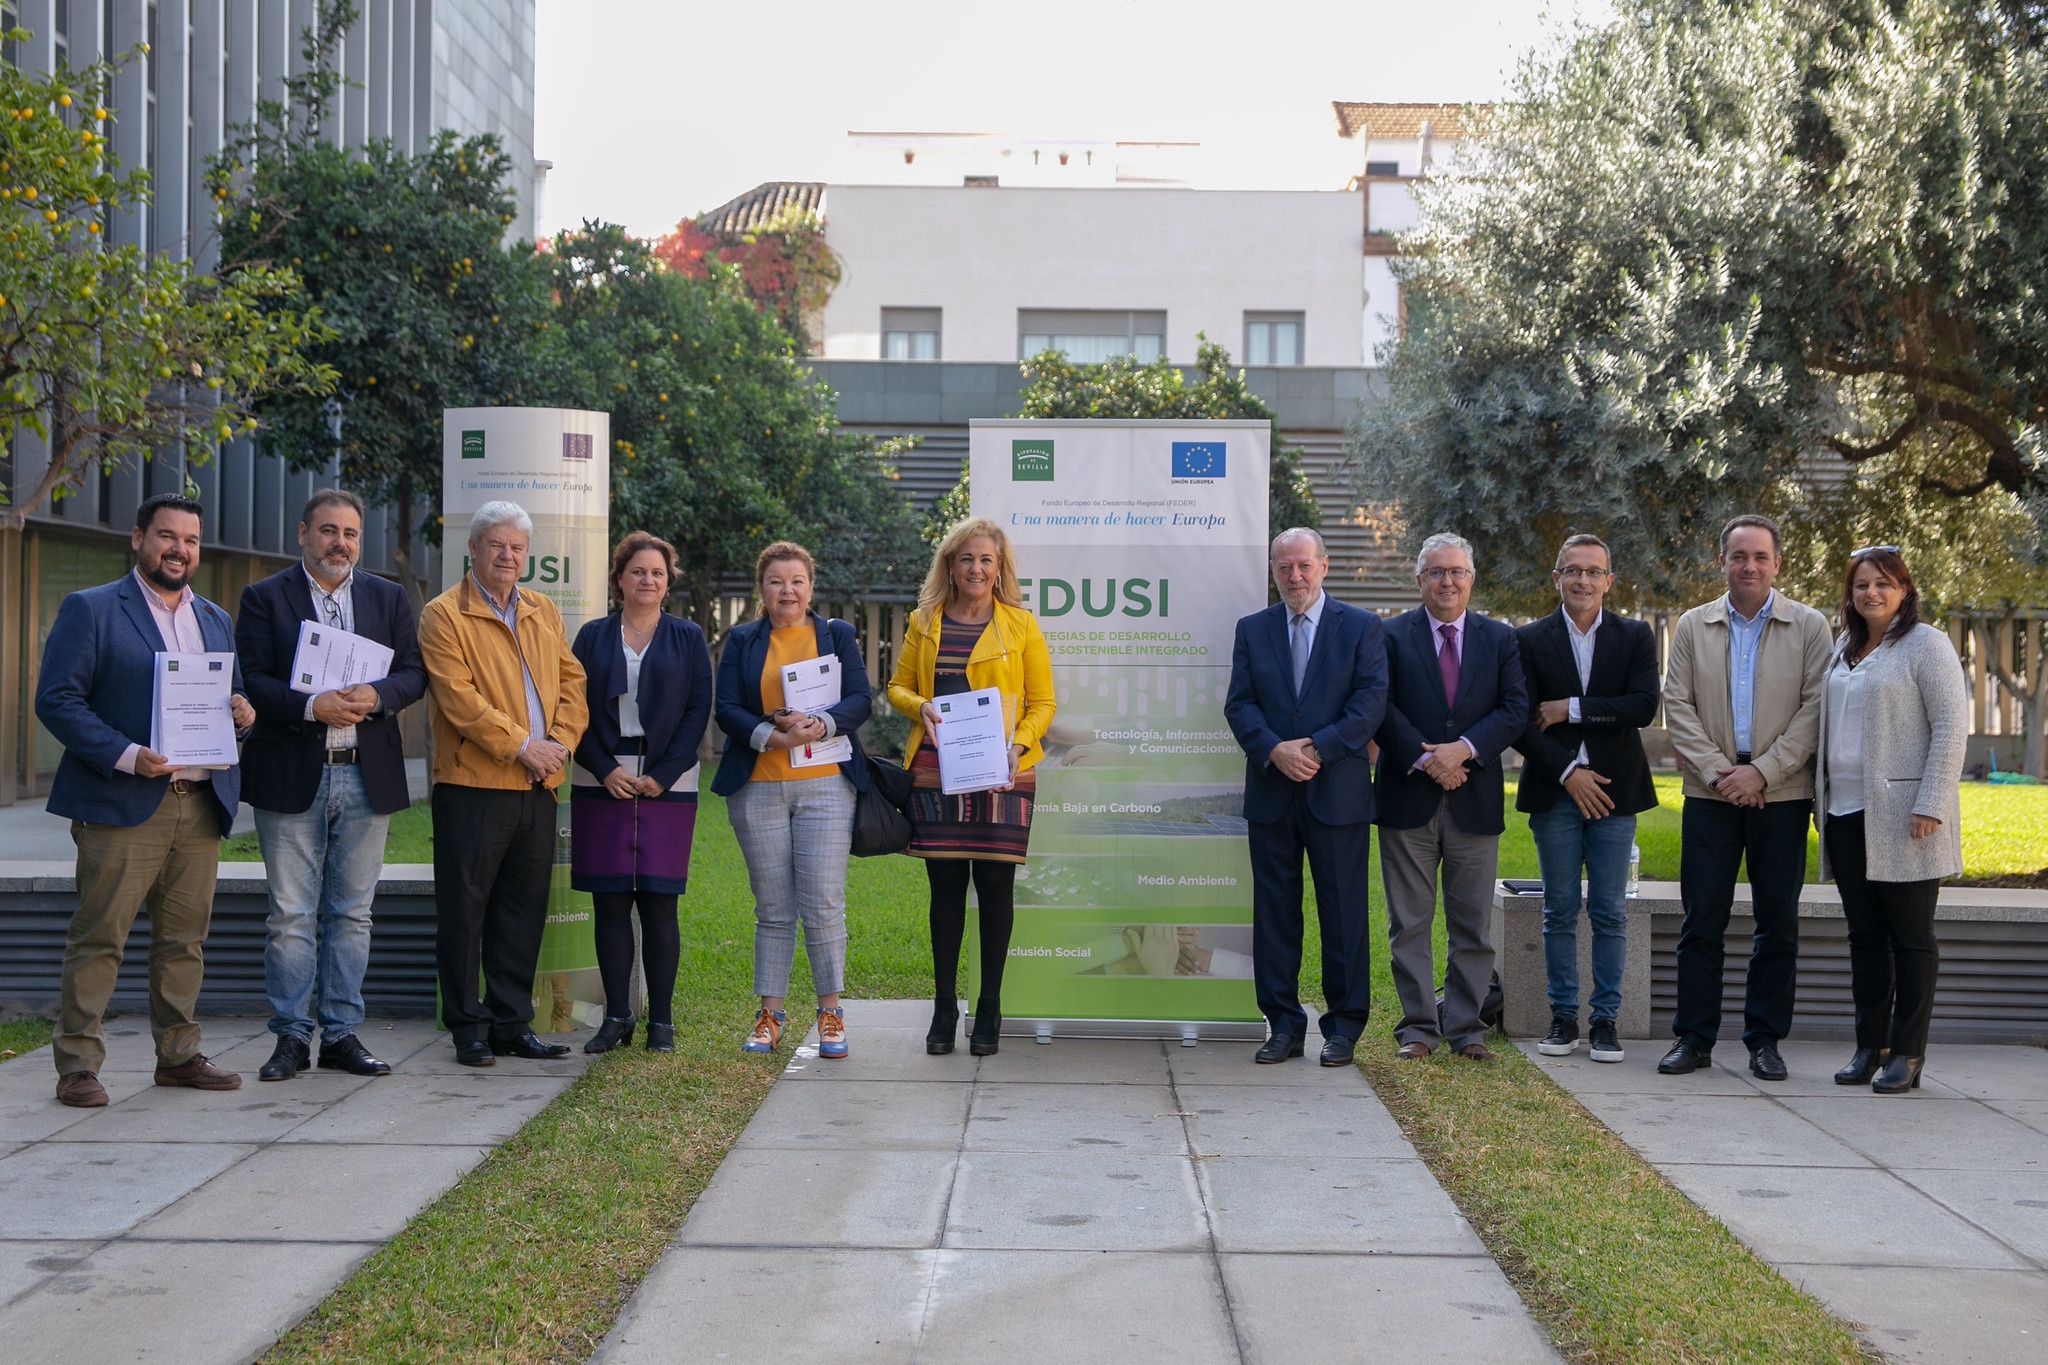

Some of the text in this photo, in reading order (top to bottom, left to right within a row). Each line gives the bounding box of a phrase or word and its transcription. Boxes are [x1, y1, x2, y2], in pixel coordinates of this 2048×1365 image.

[461, 480, 592, 494] Una manera de hacer Europa
[1064, 500, 1091, 508] Europeo
[1137, 500, 1165, 508] Regional
[1166, 500, 1196, 508] (FEDER)
[1011, 512, 1226, 529] Una manera de hacer Europa
[1043, 632, 1191, 641] TEGIAS DE DESARROLLO
[1058, 646, 1132, 656] SOSTENIBLE
[1136, 646, 1208, 656] INTEGRADO
[1093, 728, 1162, 744] Tecnología,
[1129, 742, 1238, 754] y Comunicaciones
[1032, 802, 1162, 816] omía Baja en Carbono
[1138, 874, 1237, 886] Medio Ambiente
[1056, 946, 1091, 958] Social
